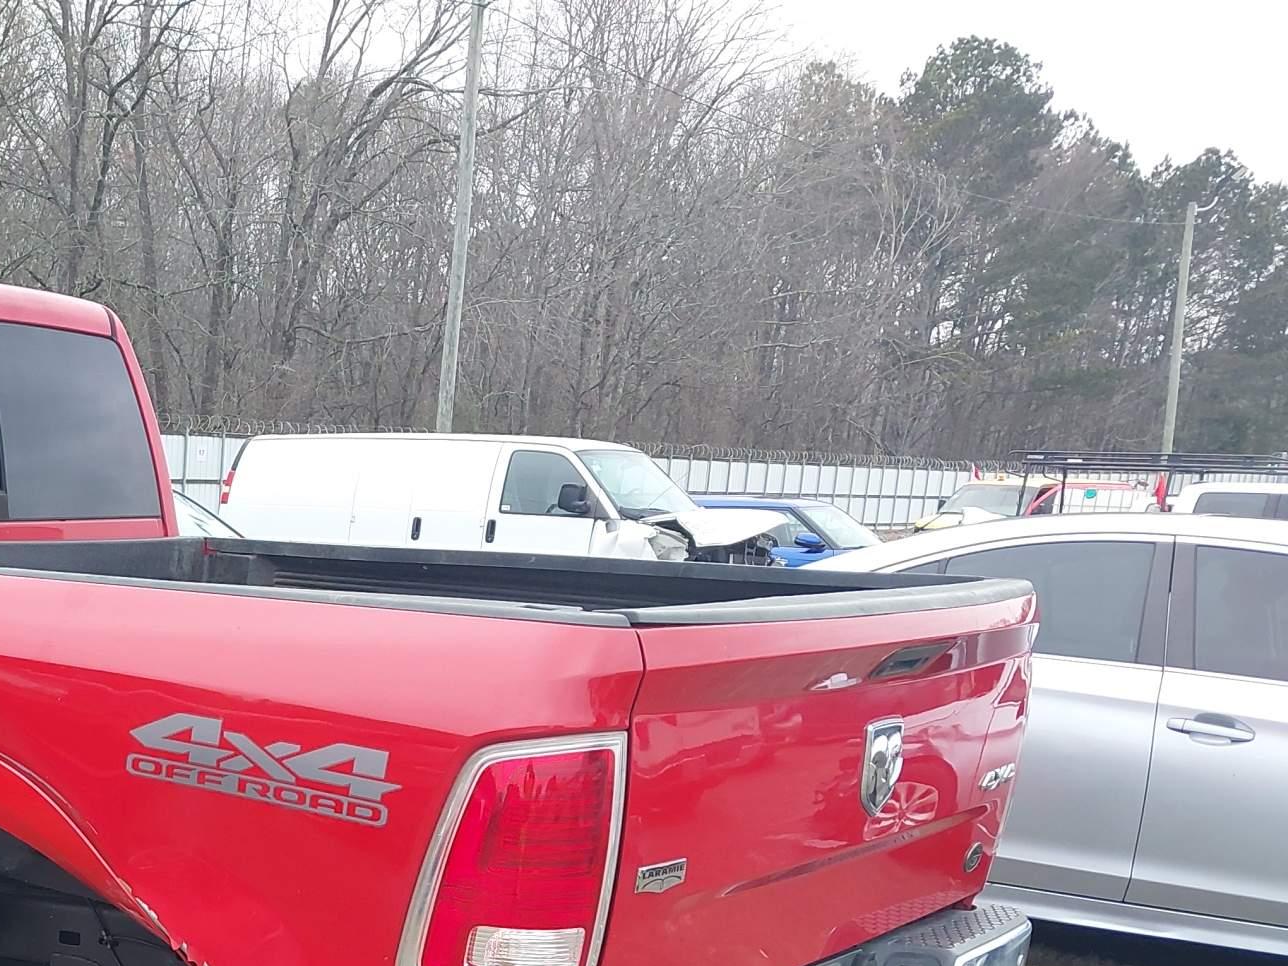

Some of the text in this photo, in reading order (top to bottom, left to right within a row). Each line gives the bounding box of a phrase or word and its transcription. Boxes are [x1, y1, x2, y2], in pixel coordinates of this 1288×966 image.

[131, 756, 381, 822] OFF ROAD
[642, 863, 685, 880] LARAMIE
